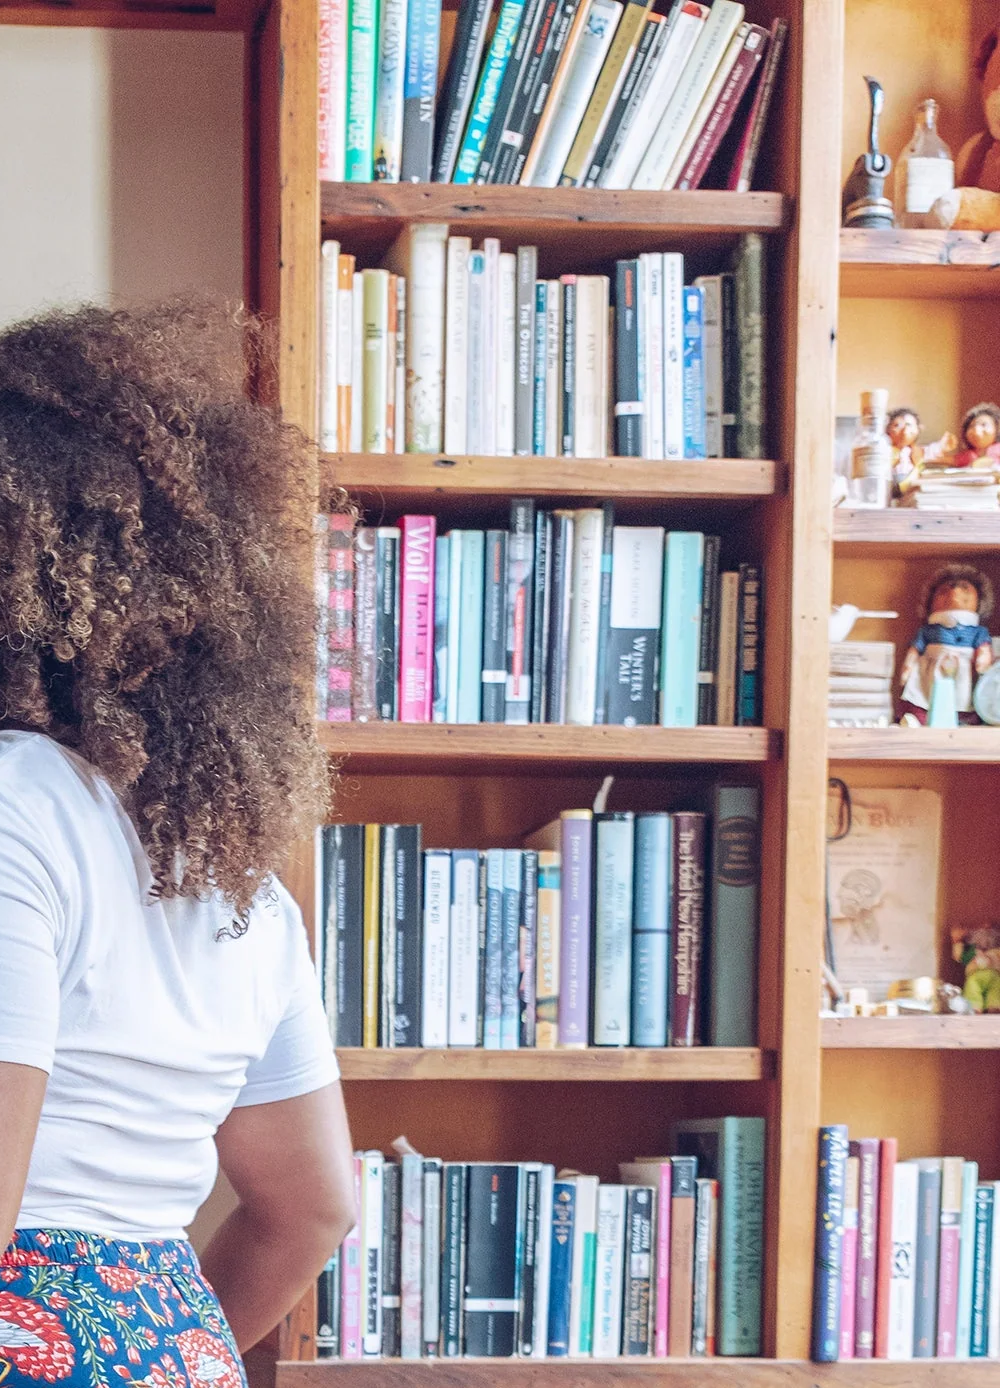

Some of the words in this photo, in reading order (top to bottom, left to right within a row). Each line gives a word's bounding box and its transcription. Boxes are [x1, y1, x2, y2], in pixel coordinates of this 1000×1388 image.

[419, 32, 438, 123] MOUNTAIN
[405, 525, 430, 583] Wolf
[405, 593, 428, 637] Hall
[617, 651, 632, 686] TALE
[629, 635, 647, 703] WINTER'S
[680, 830, 696, 855] The
[678, 855, 696, 891] Hotel
[678, 893, 695, 923] New
[674, 923, 695, 995] Hampshire
[828, 1132, 845, 1187] HARPER
[827, 1192, 842, 1219] LEE
